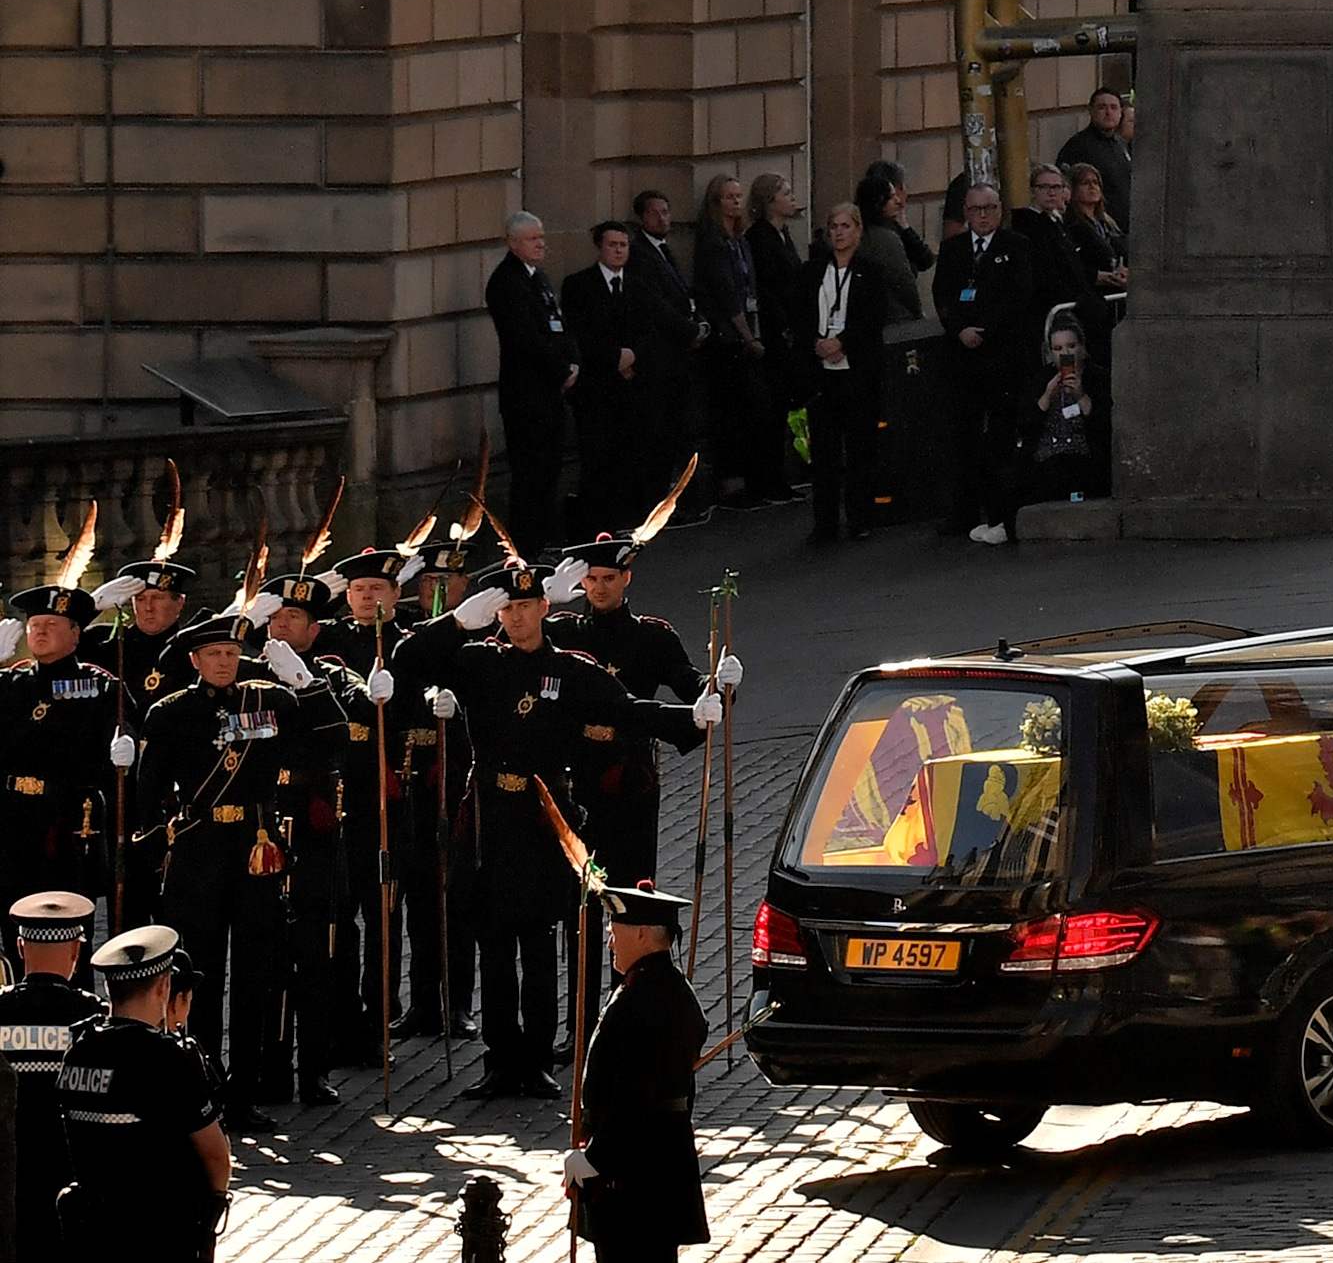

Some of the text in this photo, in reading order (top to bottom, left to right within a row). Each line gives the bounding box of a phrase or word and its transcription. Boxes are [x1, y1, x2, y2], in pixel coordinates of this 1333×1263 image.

[862, 942, 947, 968] WP 4597
[0, 1026, 71, 1051] POLICE
[59, 1066, 114, 1094] POLICE
